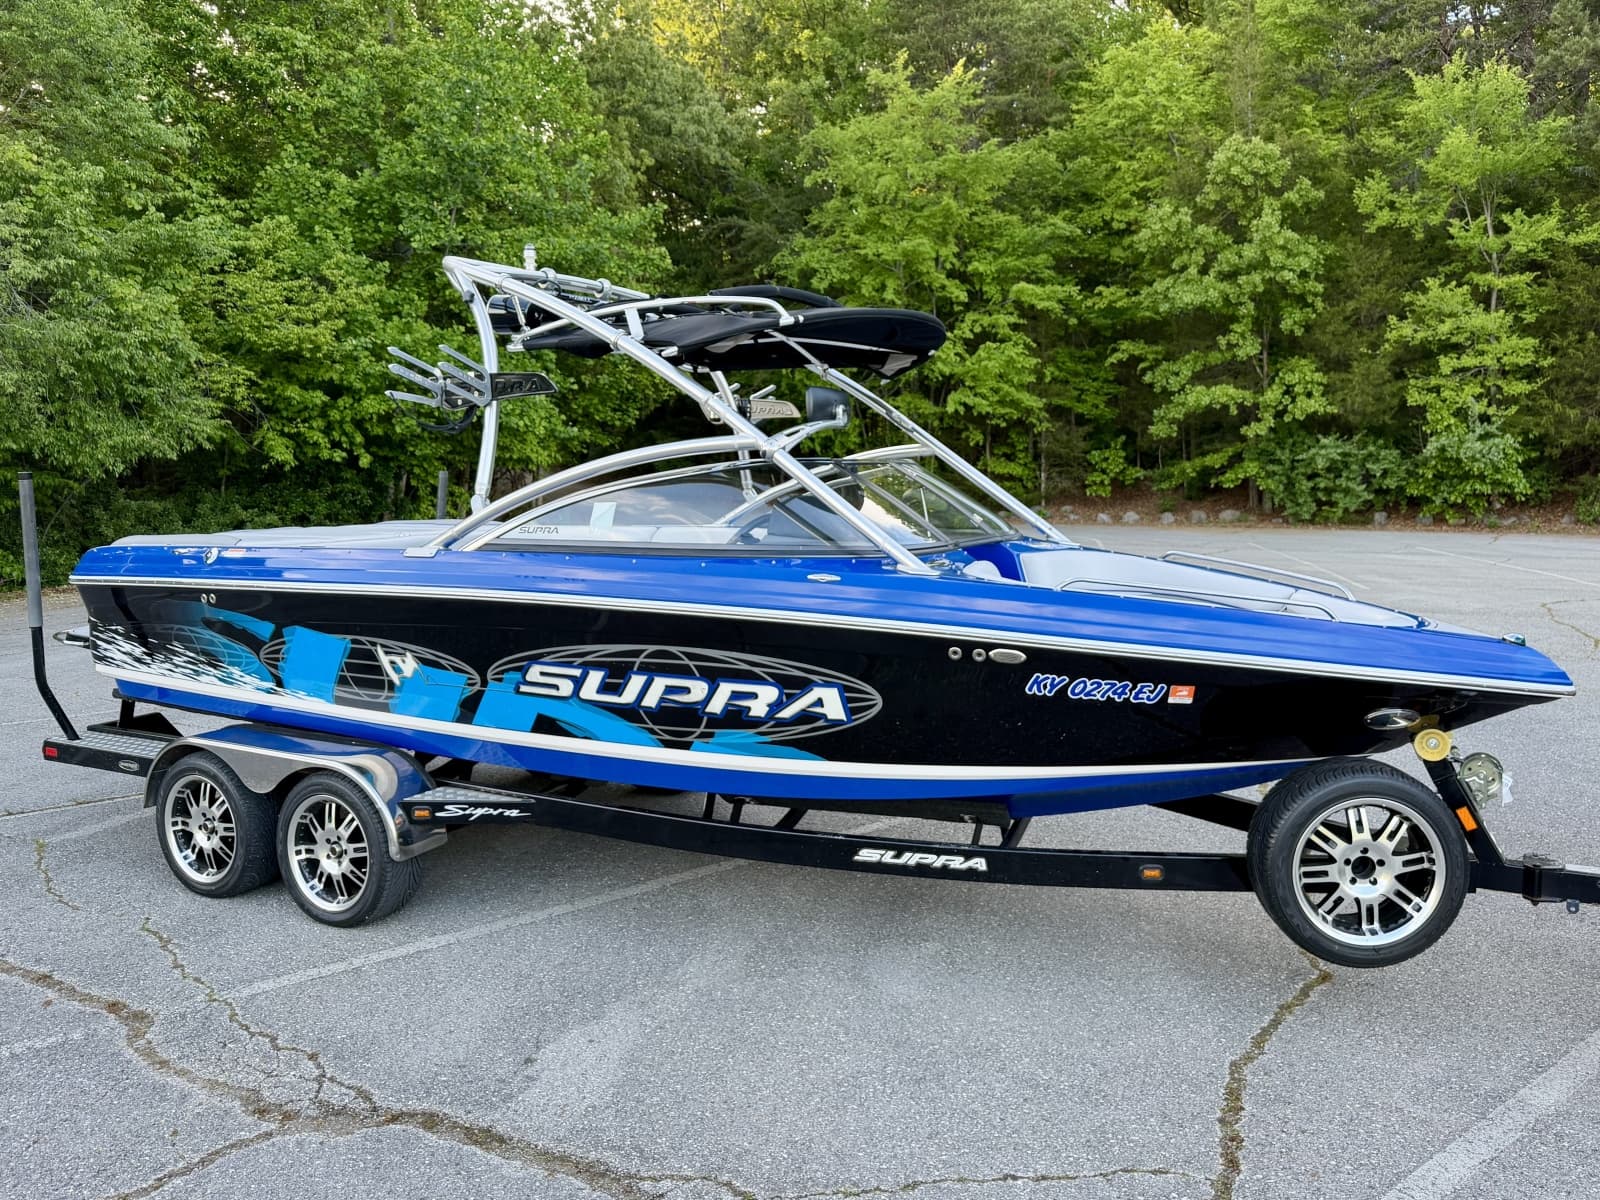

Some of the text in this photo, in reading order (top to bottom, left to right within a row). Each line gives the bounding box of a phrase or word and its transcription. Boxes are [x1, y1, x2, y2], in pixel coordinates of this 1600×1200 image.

[519, 526, 559, 534] SUPRA
[514, 661, 850, 724] SUPRA
[1025, 673, 1069, 696] KY
[1068, 678, 1132, 702] 0274
[1130, 683, 1167, 704] EJ
[435, 804, 532, 821] Supra
[853, 848, 988, 871] SUPRA
